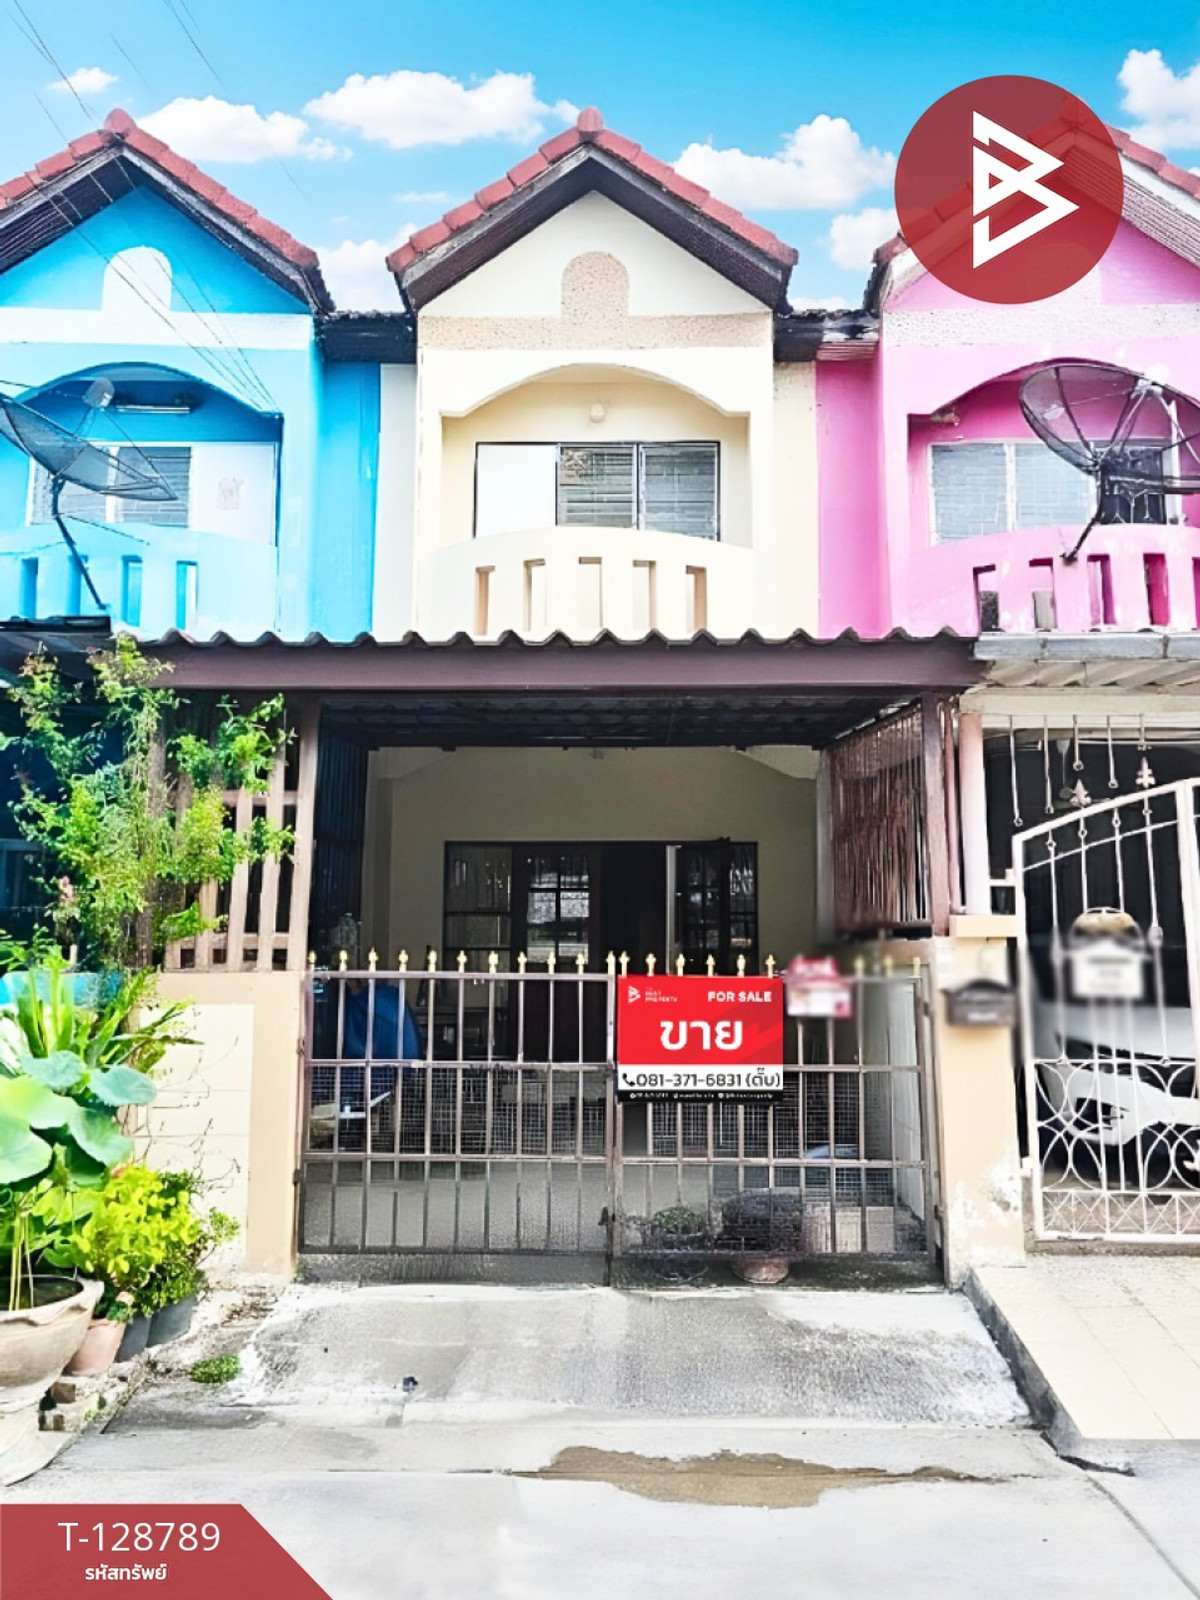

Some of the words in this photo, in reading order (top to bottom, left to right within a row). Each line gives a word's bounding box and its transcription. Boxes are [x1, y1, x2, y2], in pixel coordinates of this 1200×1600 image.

[707, 990, 735, 1002] FOR
[738, 990, 772, 1002] SALE
[660, 1020, 743, 1050] ขาย
[636, 1073, 742, 1088] 081-371-6831
